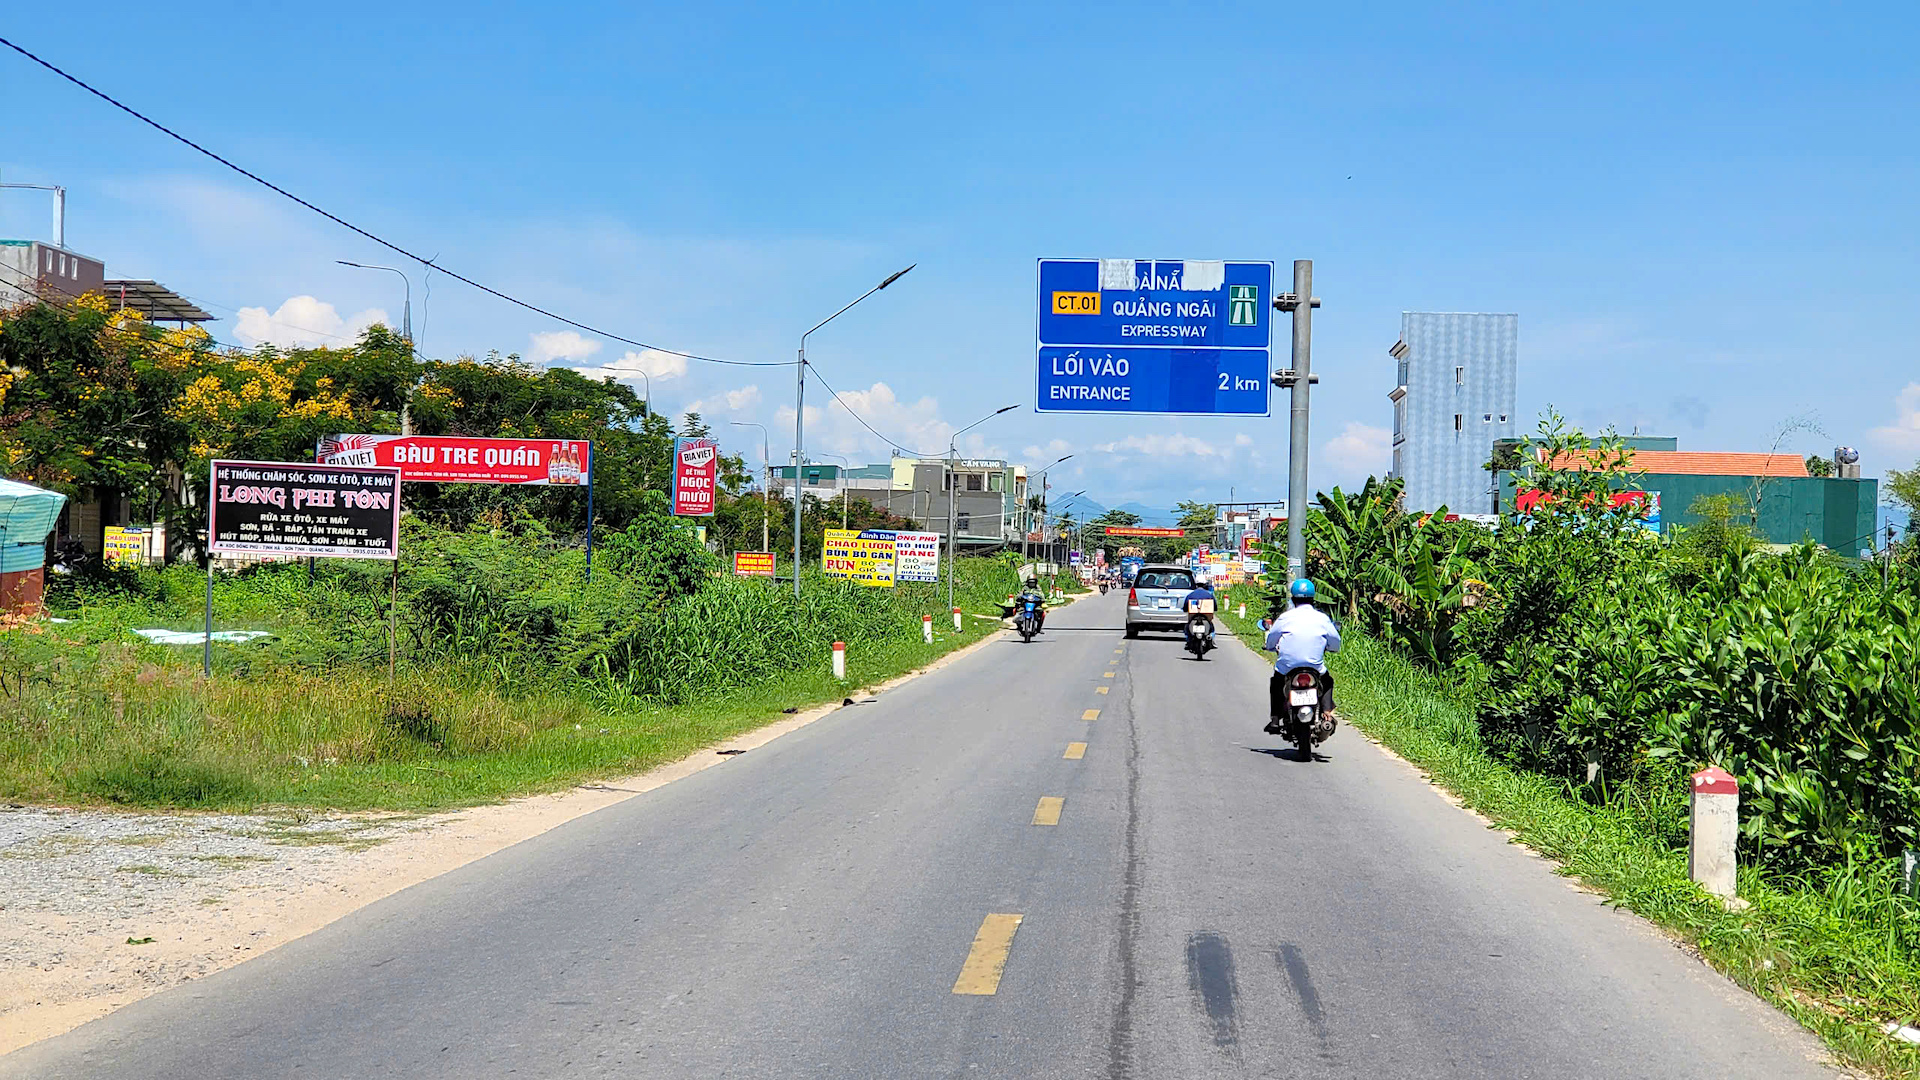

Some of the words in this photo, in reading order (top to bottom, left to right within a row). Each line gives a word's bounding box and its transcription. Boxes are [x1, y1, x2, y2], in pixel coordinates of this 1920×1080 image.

[1057, 296, 1097, 311] CT.01
[1112, 297, 1172, 318] QUẢNG
[1176, 299, 1216, 318] NGÃI
[1121, 325, 1208, 338] EXPRESSWAY
[1052, 351, 1084, 376] LỐI
[1089, 354, 1130, 376] VÀO
[1218, 373, 1230, 391] 2
[1235, 376, 1260, 391] km
[1050, 386, 1131, 401] ENTRANCE
[348, 451, 372, 466] VIỆT
[393, 442, 435, 463] BÀU
[441, 447, 479, 464] TRE
[484, 446, 540, 468] QUÁN
[218, 467, 230, 481] HỆ
[231, 467, 261, 481] THỐNG
[262, 470, 287, 482] CHĂM
[288, 471, 307, 484] SÓC,
[308, 473, 326, 484] SƠN
[327, 474, 339, 485] XE
[340, 473, 361, 487] ÔTÔ,
[362, 476, 373, 486] XE
[374, 475, 394, 487] MÁY
[680, 476, 711, 490] NGỌC
[218, 484, 287, 510] LONG
[292, 487, 336, 510] PHI
[340, 488, 392, 510] TÔN
[679, 490, 711, 503] MƯỜI
[260, 511, 278, 522] RỬA
[280, 514, 292, 522] XE
[293, 513, 315, 524] ÔTÔ,
[316, 516, 328, 524] XE
[329, 515, 349, 525] MÁY
[240, 522, 260, 532] SƠN,
[306, 524, 325, 534] TÂN
[326, 526, 355, 536] TRANG
[356, 528, 369, 536] XE
[219, 531, 238, 540] HÚT
[263, 533, 282, 543] HÀN
[312, 536, 330, 545] SƠN
[364, 537, 387, 547] TUỐT
[826, 547, 848, 557] BÚN
[852, 549, 867, 558] BÒ
[900, 548, 936, 557] UẢNG
